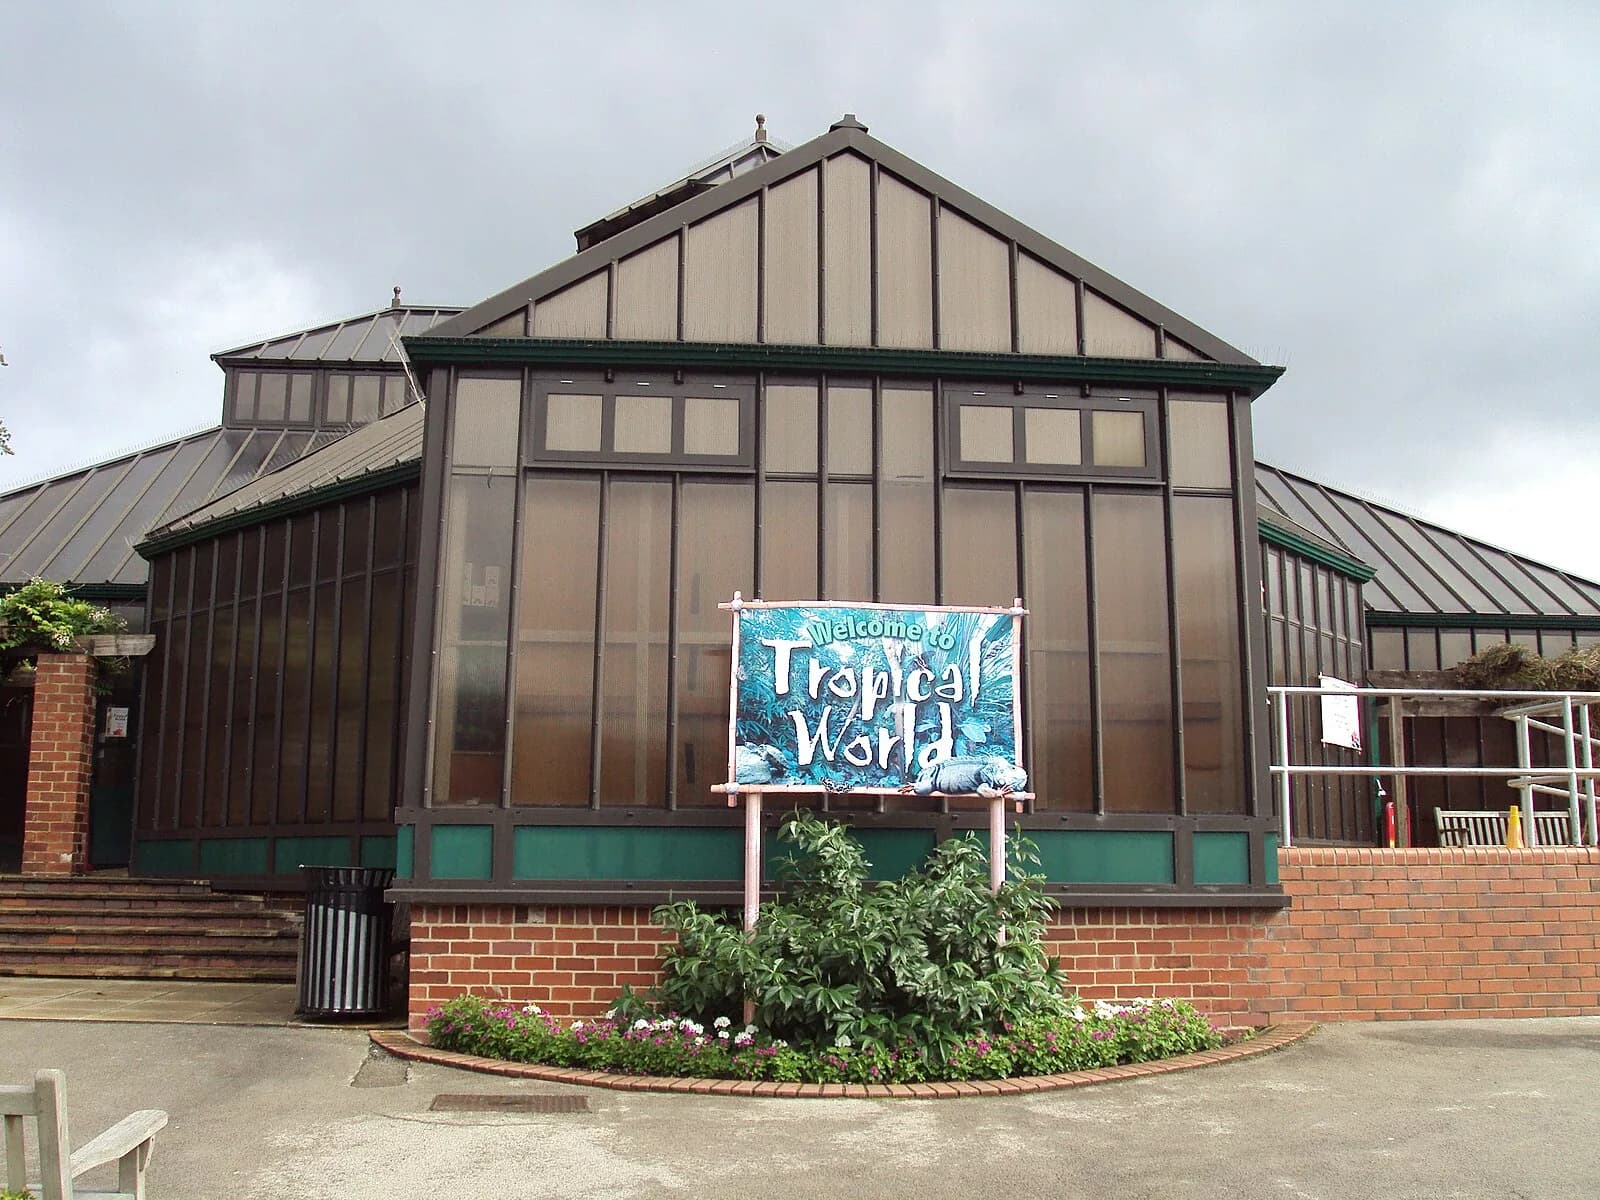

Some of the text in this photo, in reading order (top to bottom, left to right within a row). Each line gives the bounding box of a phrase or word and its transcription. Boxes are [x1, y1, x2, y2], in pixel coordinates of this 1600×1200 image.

[808, 616, 955, 650] Welcome to
[763, 632, 982, 721] Tropical
[789, 702, 954, 773] World
